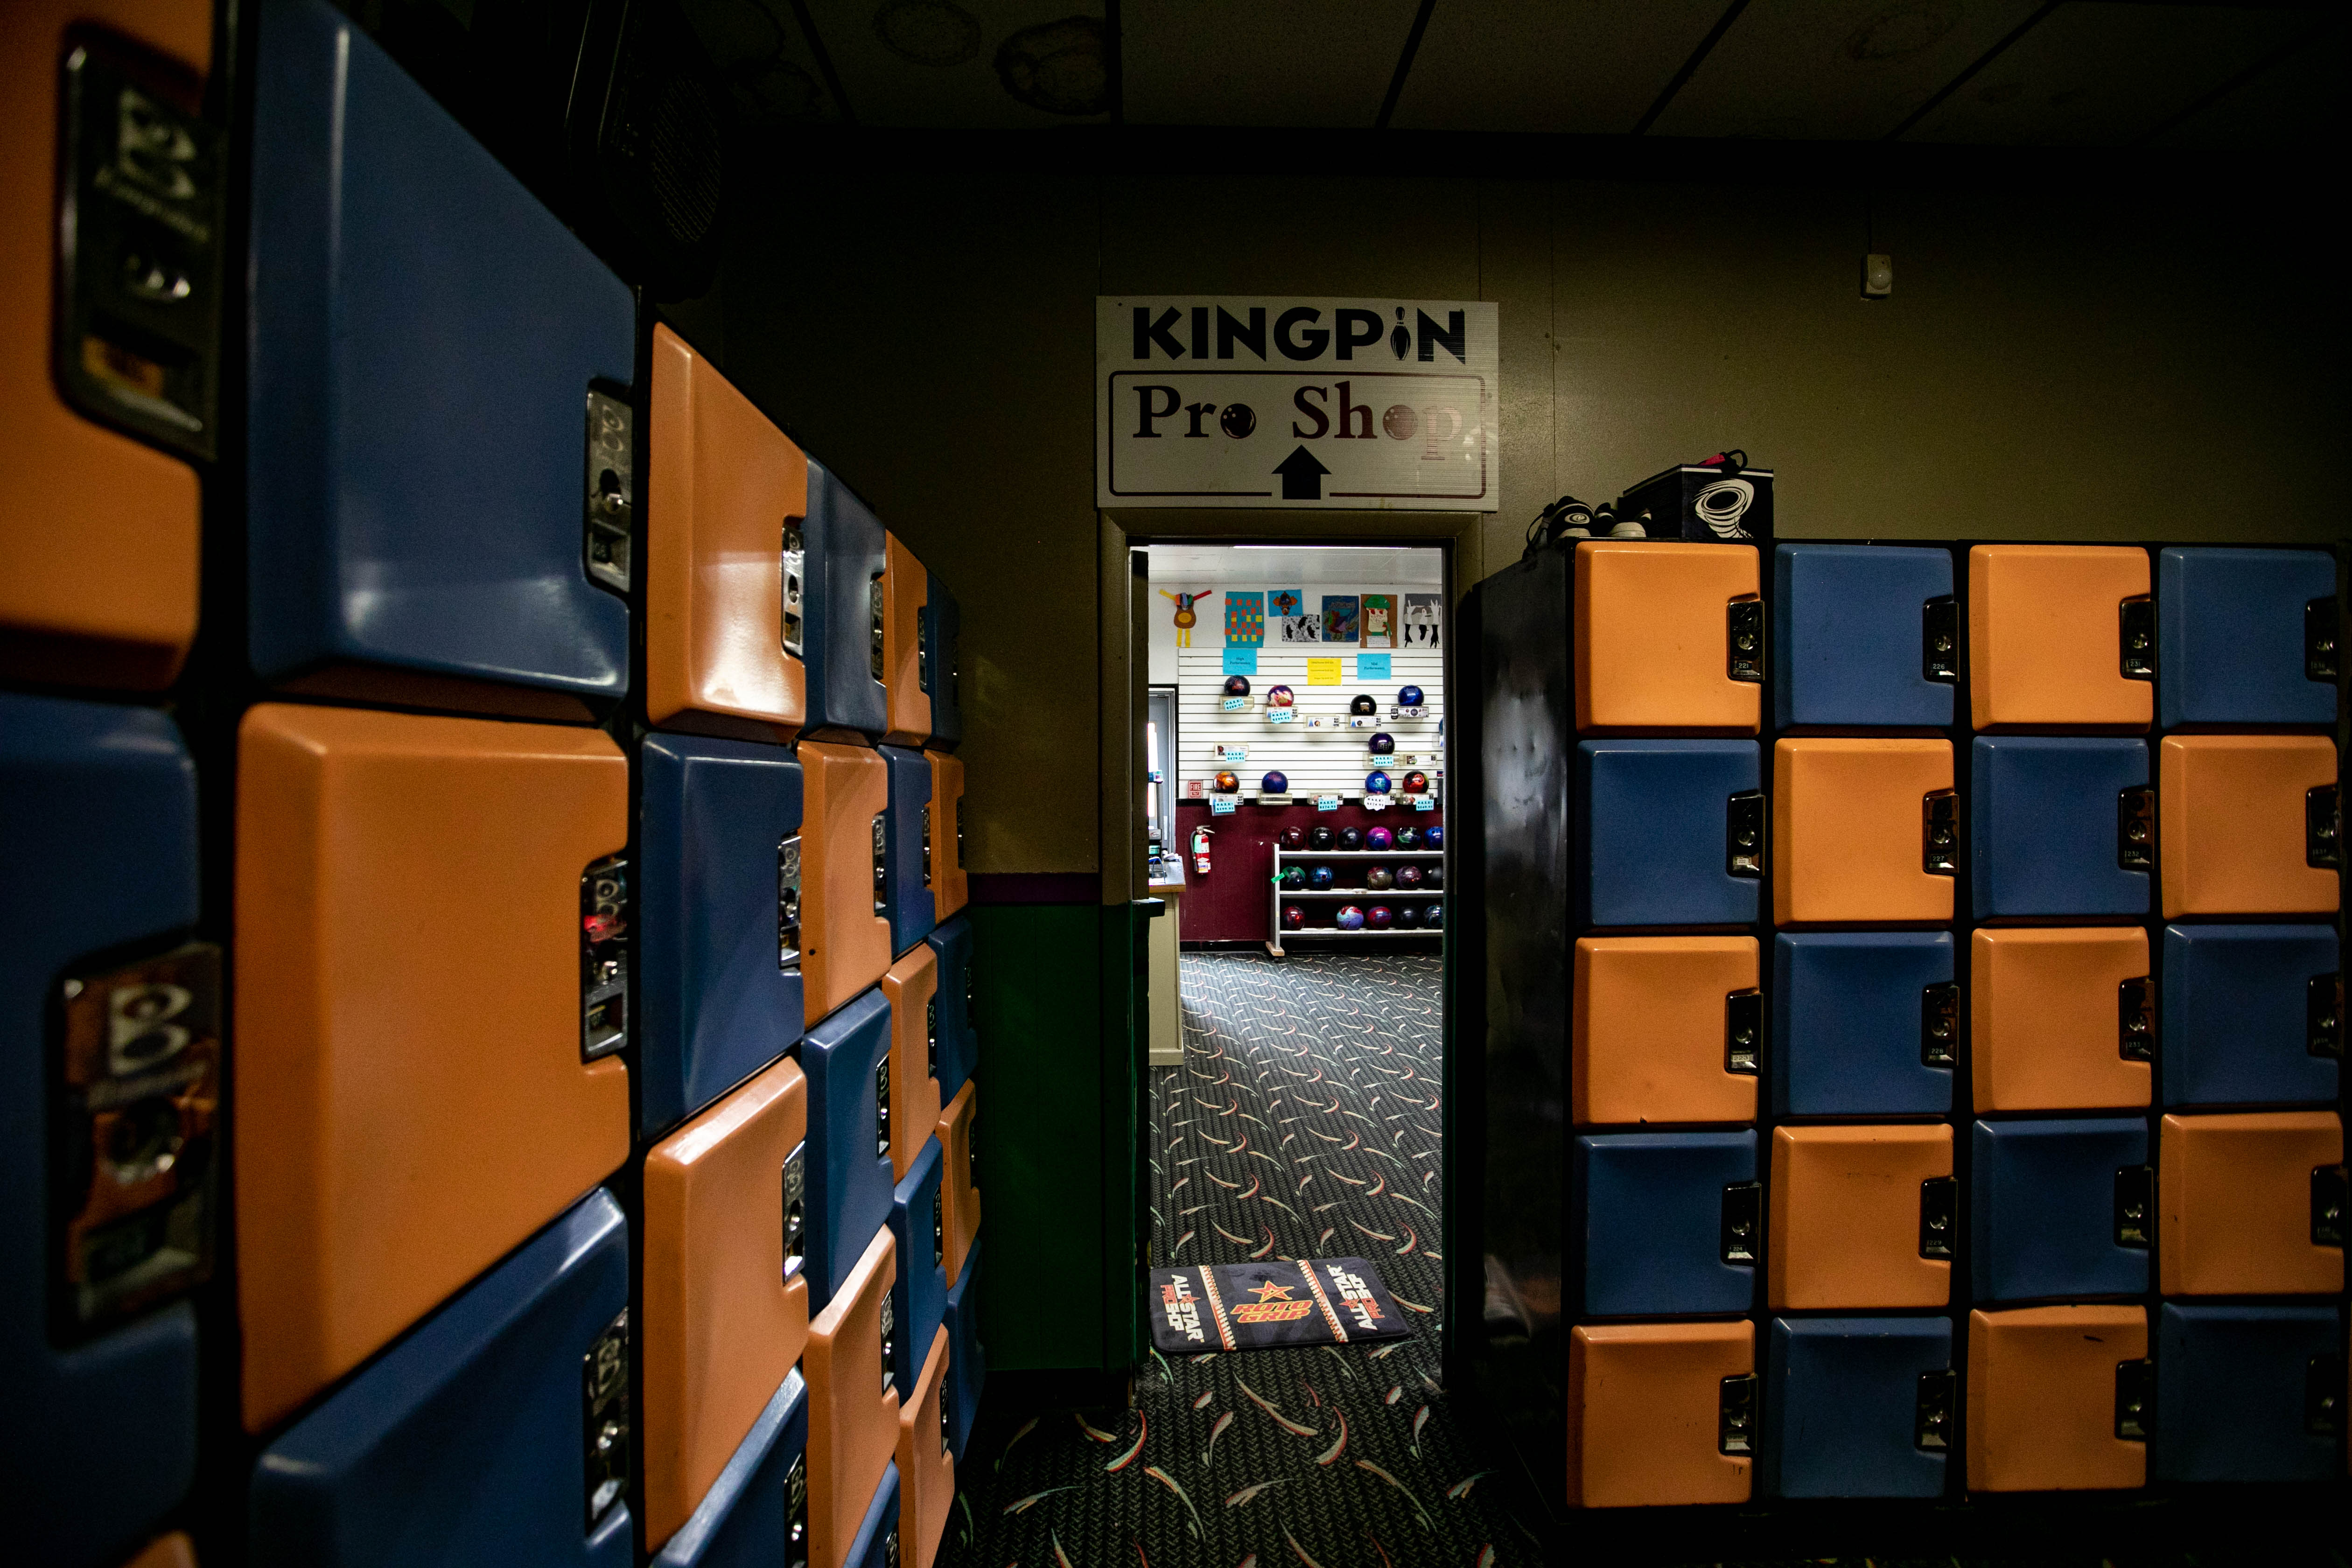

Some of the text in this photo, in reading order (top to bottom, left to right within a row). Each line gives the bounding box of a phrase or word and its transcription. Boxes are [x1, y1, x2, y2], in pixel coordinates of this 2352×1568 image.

[1133, 380, 1463, 460] Pro Shop
[1230, 1300, 1314, 1315] ROTO
[1237, 1309, 1311, 1323] GRIP
